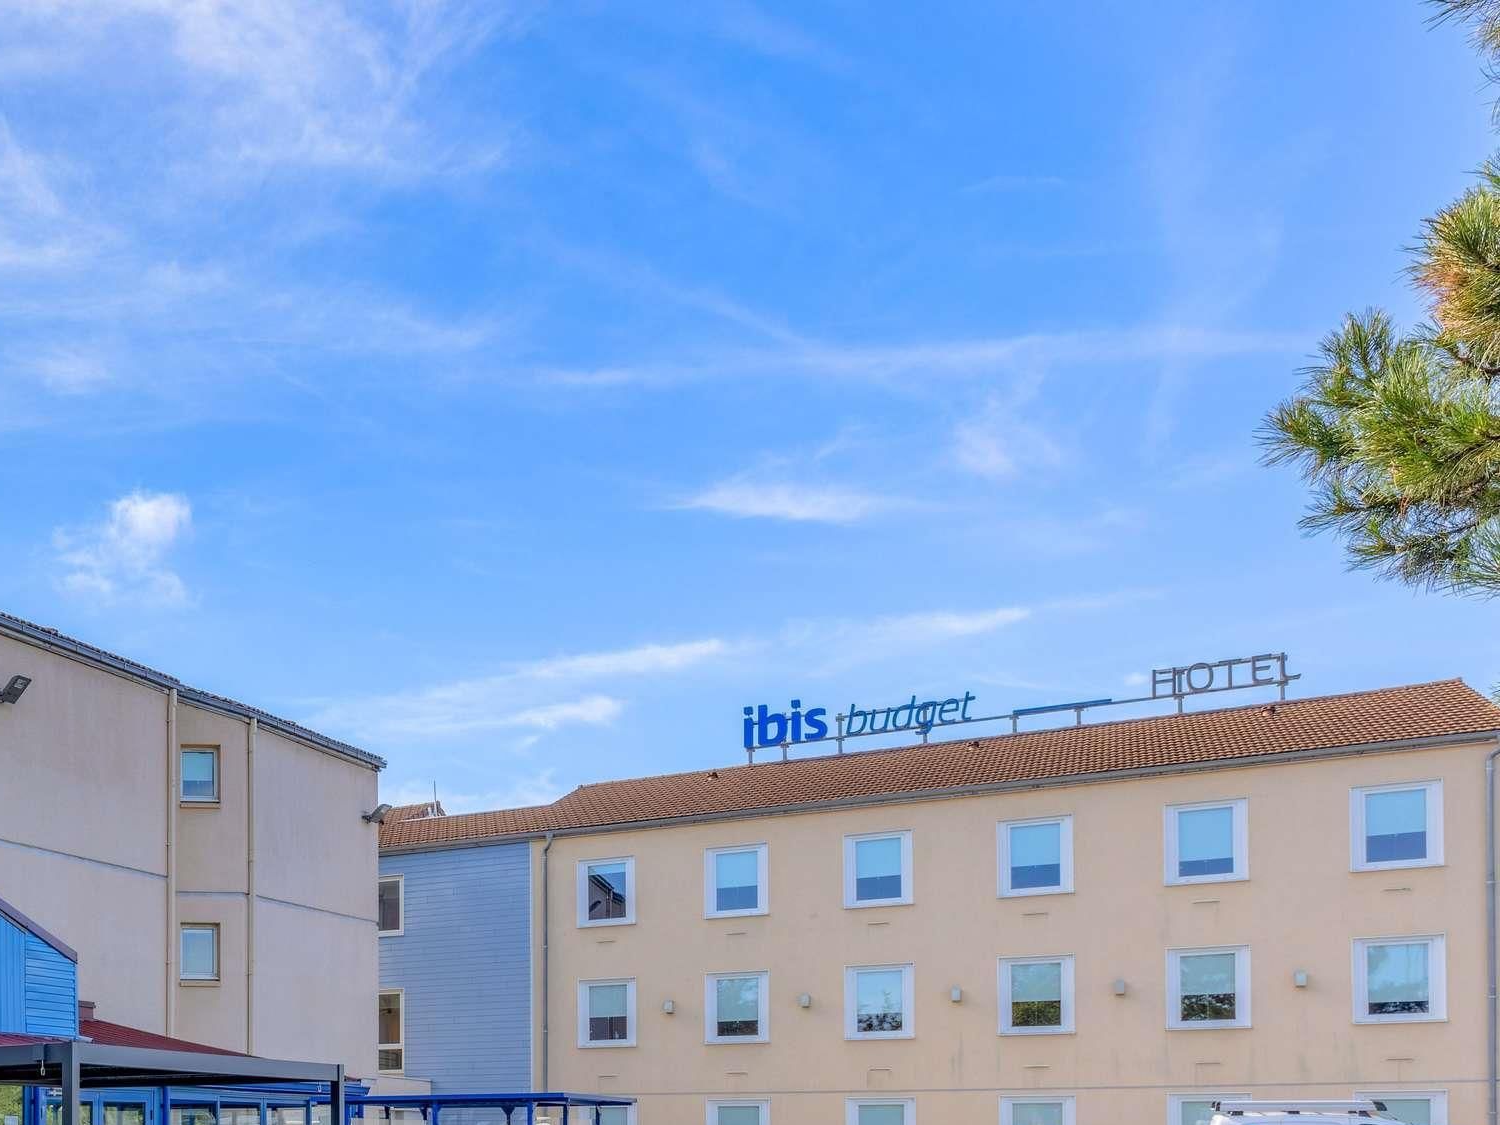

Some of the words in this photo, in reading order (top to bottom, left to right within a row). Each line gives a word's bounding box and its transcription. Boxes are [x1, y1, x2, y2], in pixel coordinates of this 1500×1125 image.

[1152, 652, 1302, 698] HOTEL
[743, 699, 828, 748] ibis
[846, 691, 976, 736] budget
